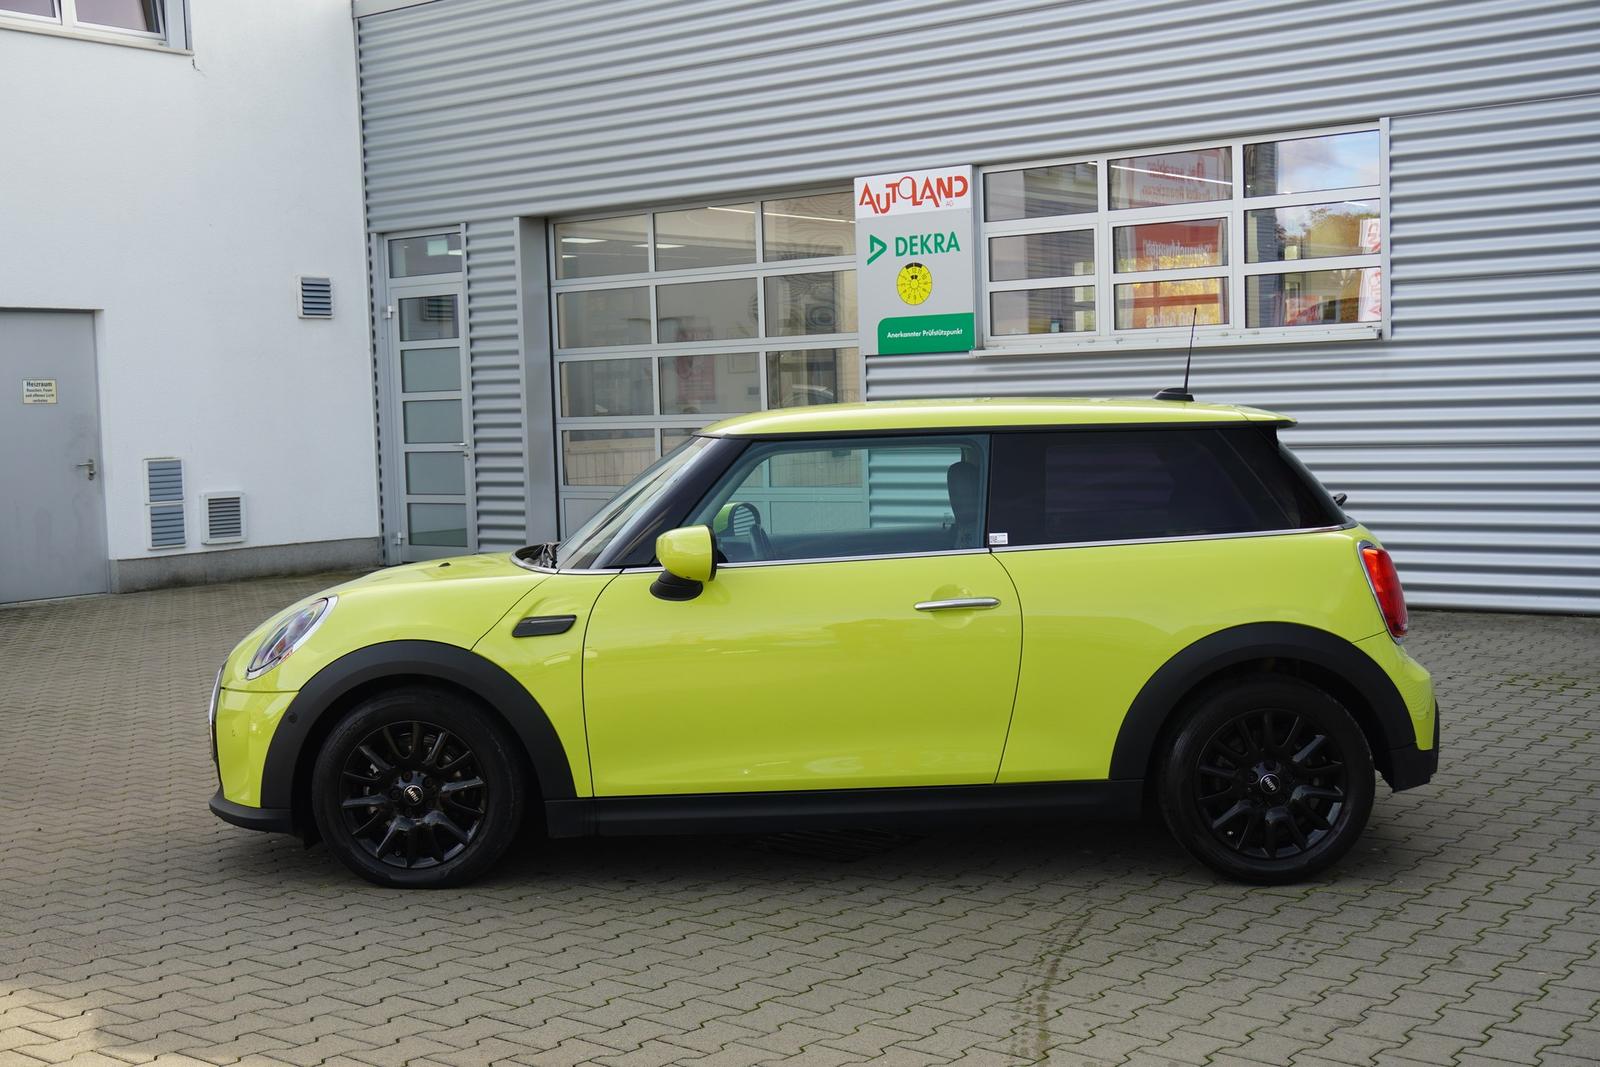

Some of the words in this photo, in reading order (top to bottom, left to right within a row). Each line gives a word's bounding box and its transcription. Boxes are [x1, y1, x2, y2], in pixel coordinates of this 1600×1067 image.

[859, 175, 969, 214] AUTOLAND
[895, 231, 961, 257] DEKRA
[886, 330, 921, 339] Anerkannter
[922, 328, 963, 337] Prüfstützpunkt
